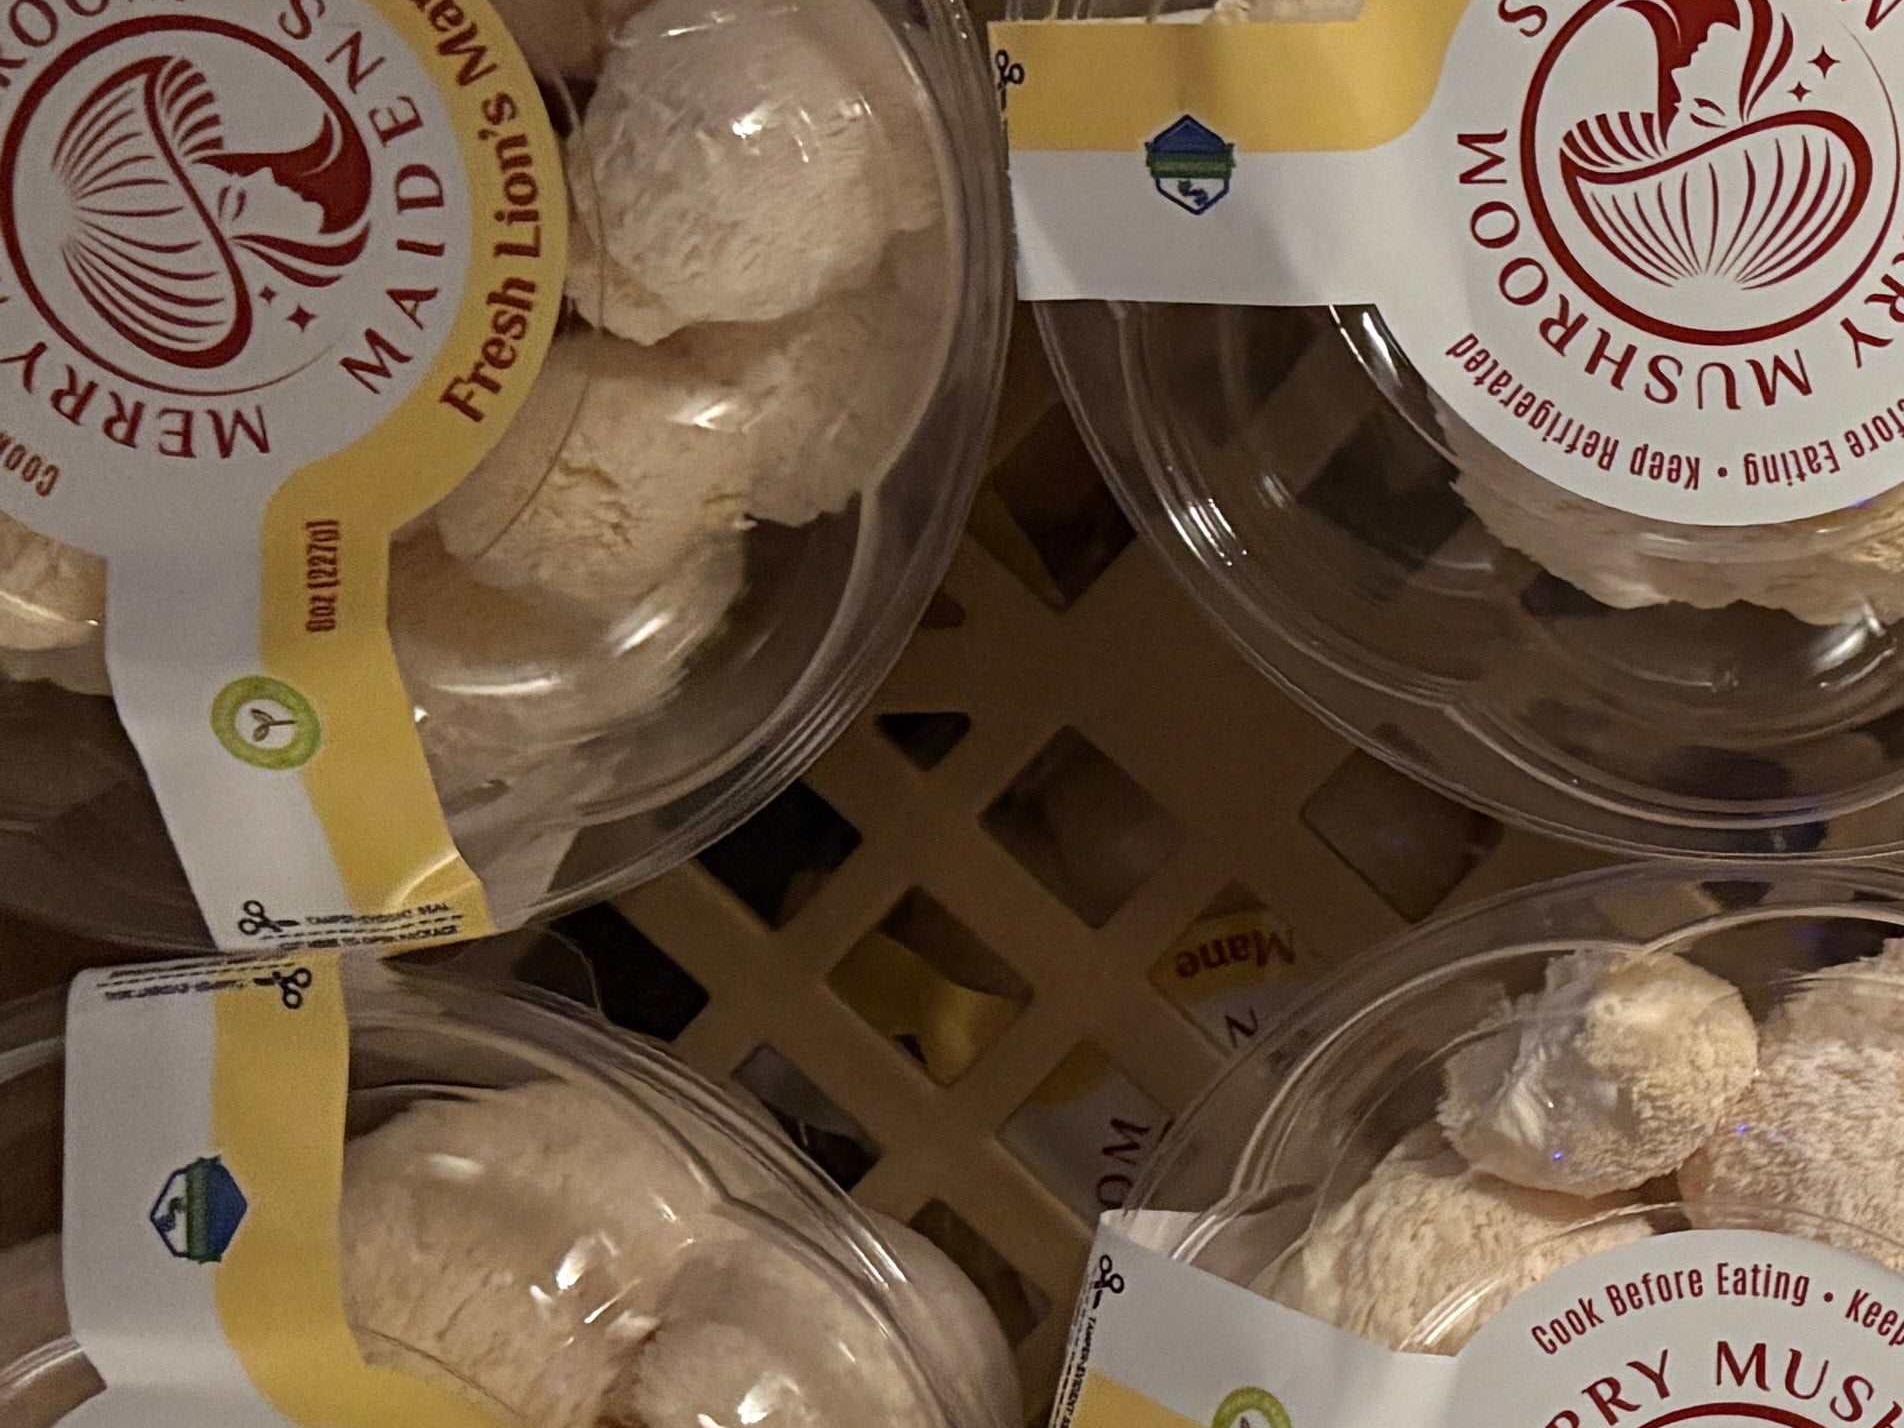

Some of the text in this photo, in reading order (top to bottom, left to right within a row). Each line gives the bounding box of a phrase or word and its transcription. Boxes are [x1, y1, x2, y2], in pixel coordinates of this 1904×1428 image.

[478, 90, 541, 257] Lion's
[1457, 131, 1812, 410] MUSHROOM
[0, 341, 268, 458] MERRY
[439, 273, 536, 421] Fresh
[1447, 334, 1619, 470] Refrigerated
[1629, 445, 1700, 489] Keep
[1742, 440, 1840, 485] Eating
[1531, 1300, 1602, 1354] Cook
[1605, 1269, 1703, 1317] Before
[1717, 1263, 1809, 1307] Eating
